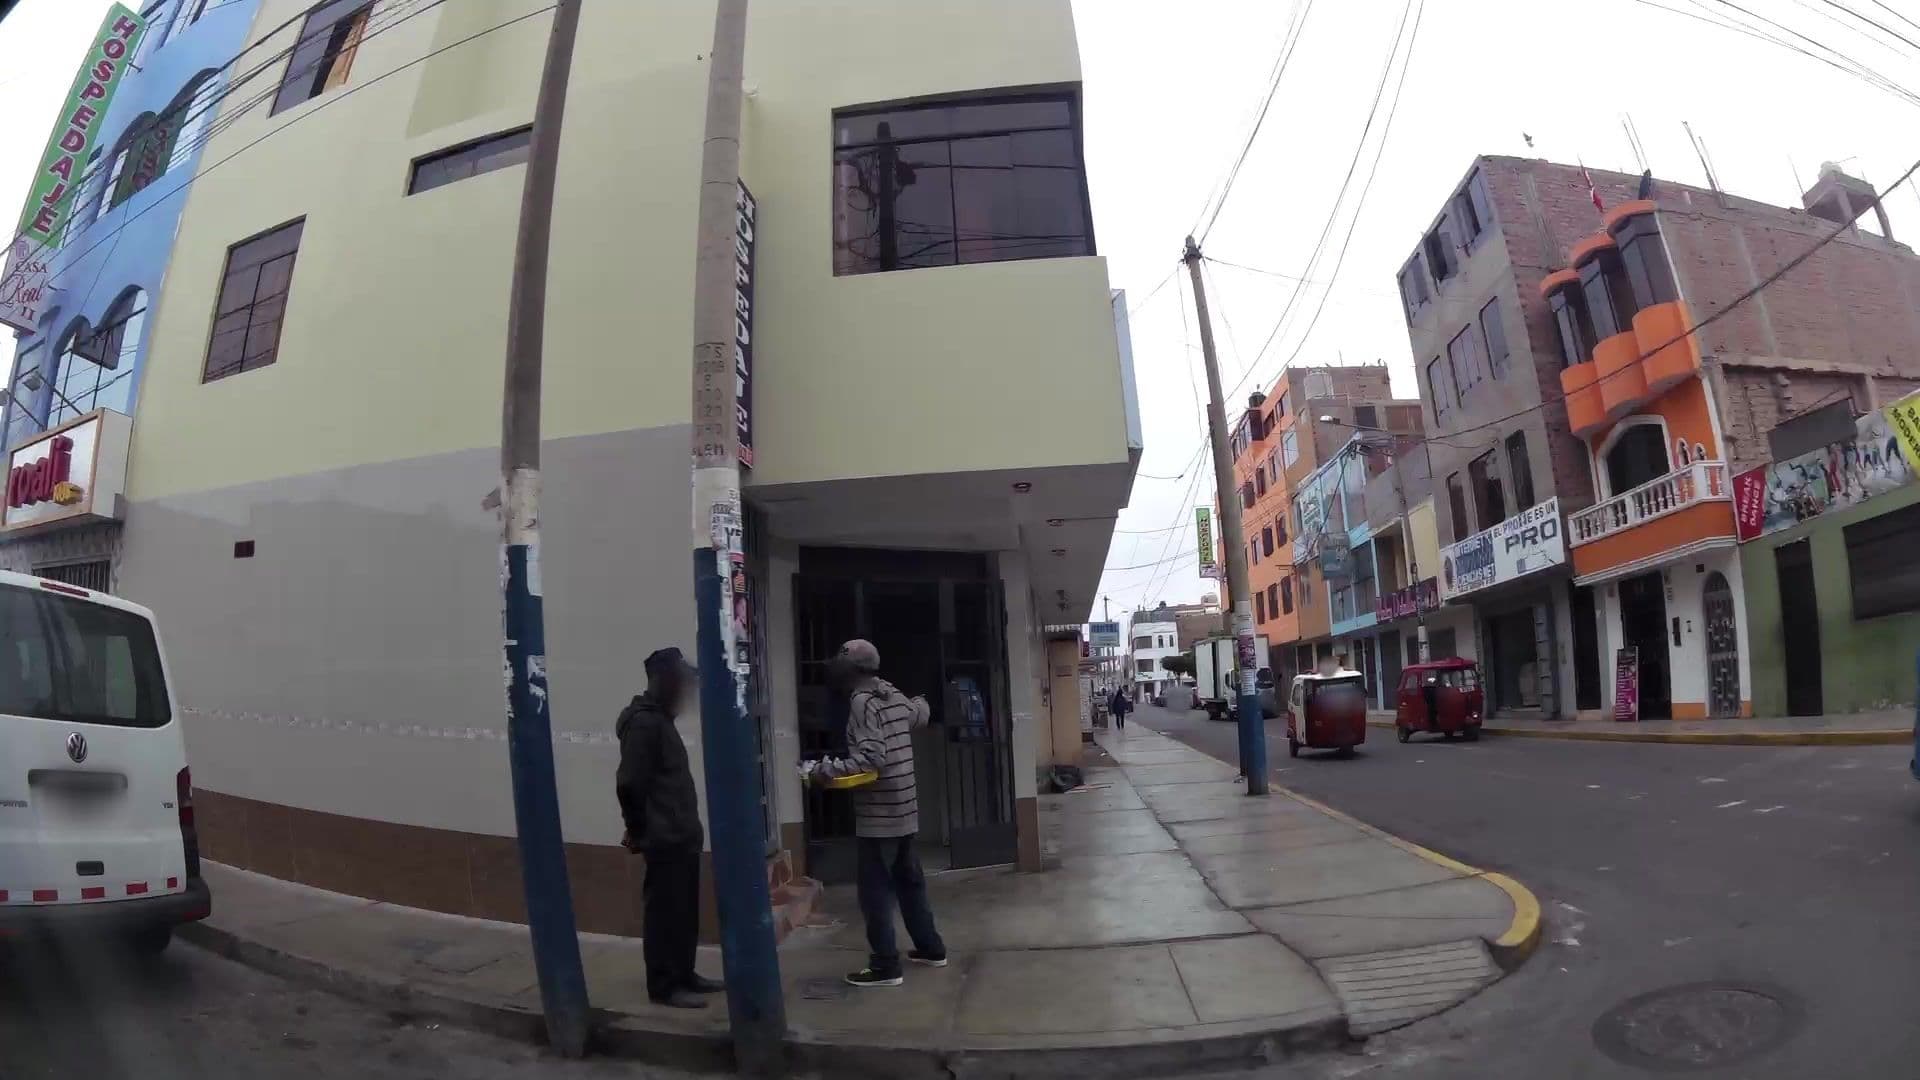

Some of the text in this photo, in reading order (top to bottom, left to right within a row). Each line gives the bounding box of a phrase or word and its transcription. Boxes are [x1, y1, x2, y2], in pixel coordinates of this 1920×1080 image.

[33, 14, 138, 235] HOSPEDAJE
[15, 261, 48, 273] CASA
[1505, 518, 1558, 555] PRO
